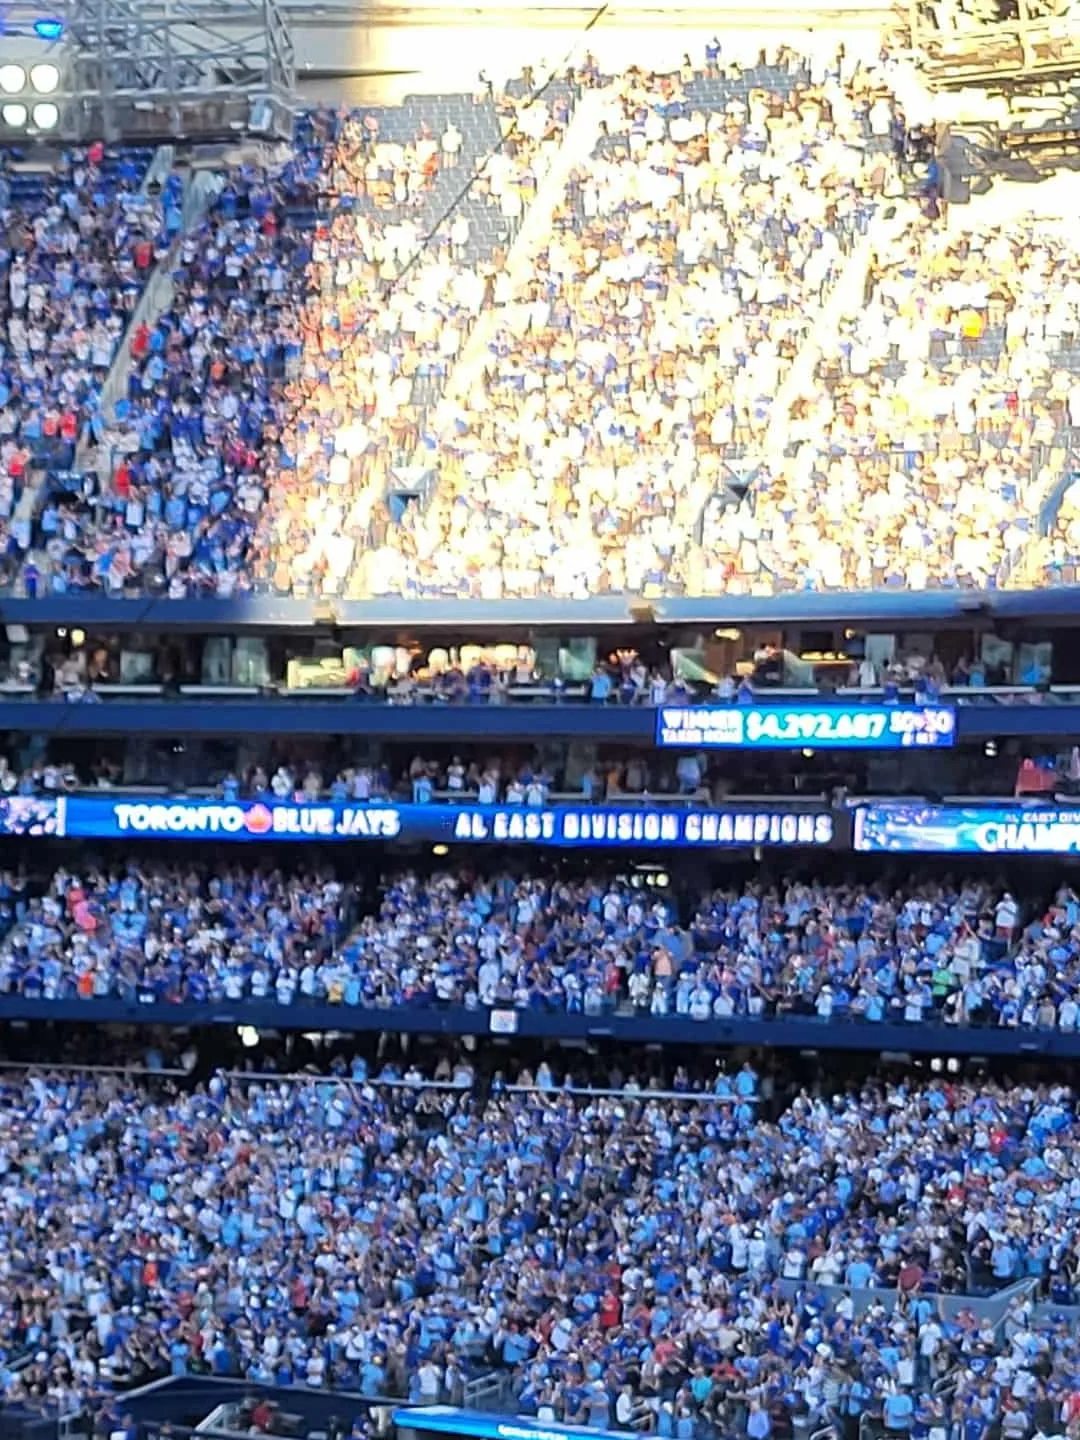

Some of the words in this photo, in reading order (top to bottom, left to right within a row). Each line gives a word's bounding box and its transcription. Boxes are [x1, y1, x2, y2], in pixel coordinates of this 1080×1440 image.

[114, 803, 245, 832] TORONTO
[273, 807, 334, 833] BLUE
[336, 809, 400, 835] JAYS
[455, 812, 487, 839] AL
[494, 812, 554, 839] EAST
[563, 813, 678, 840] DIVISION
[685, 814, 833, 842] CHAMPIONS
